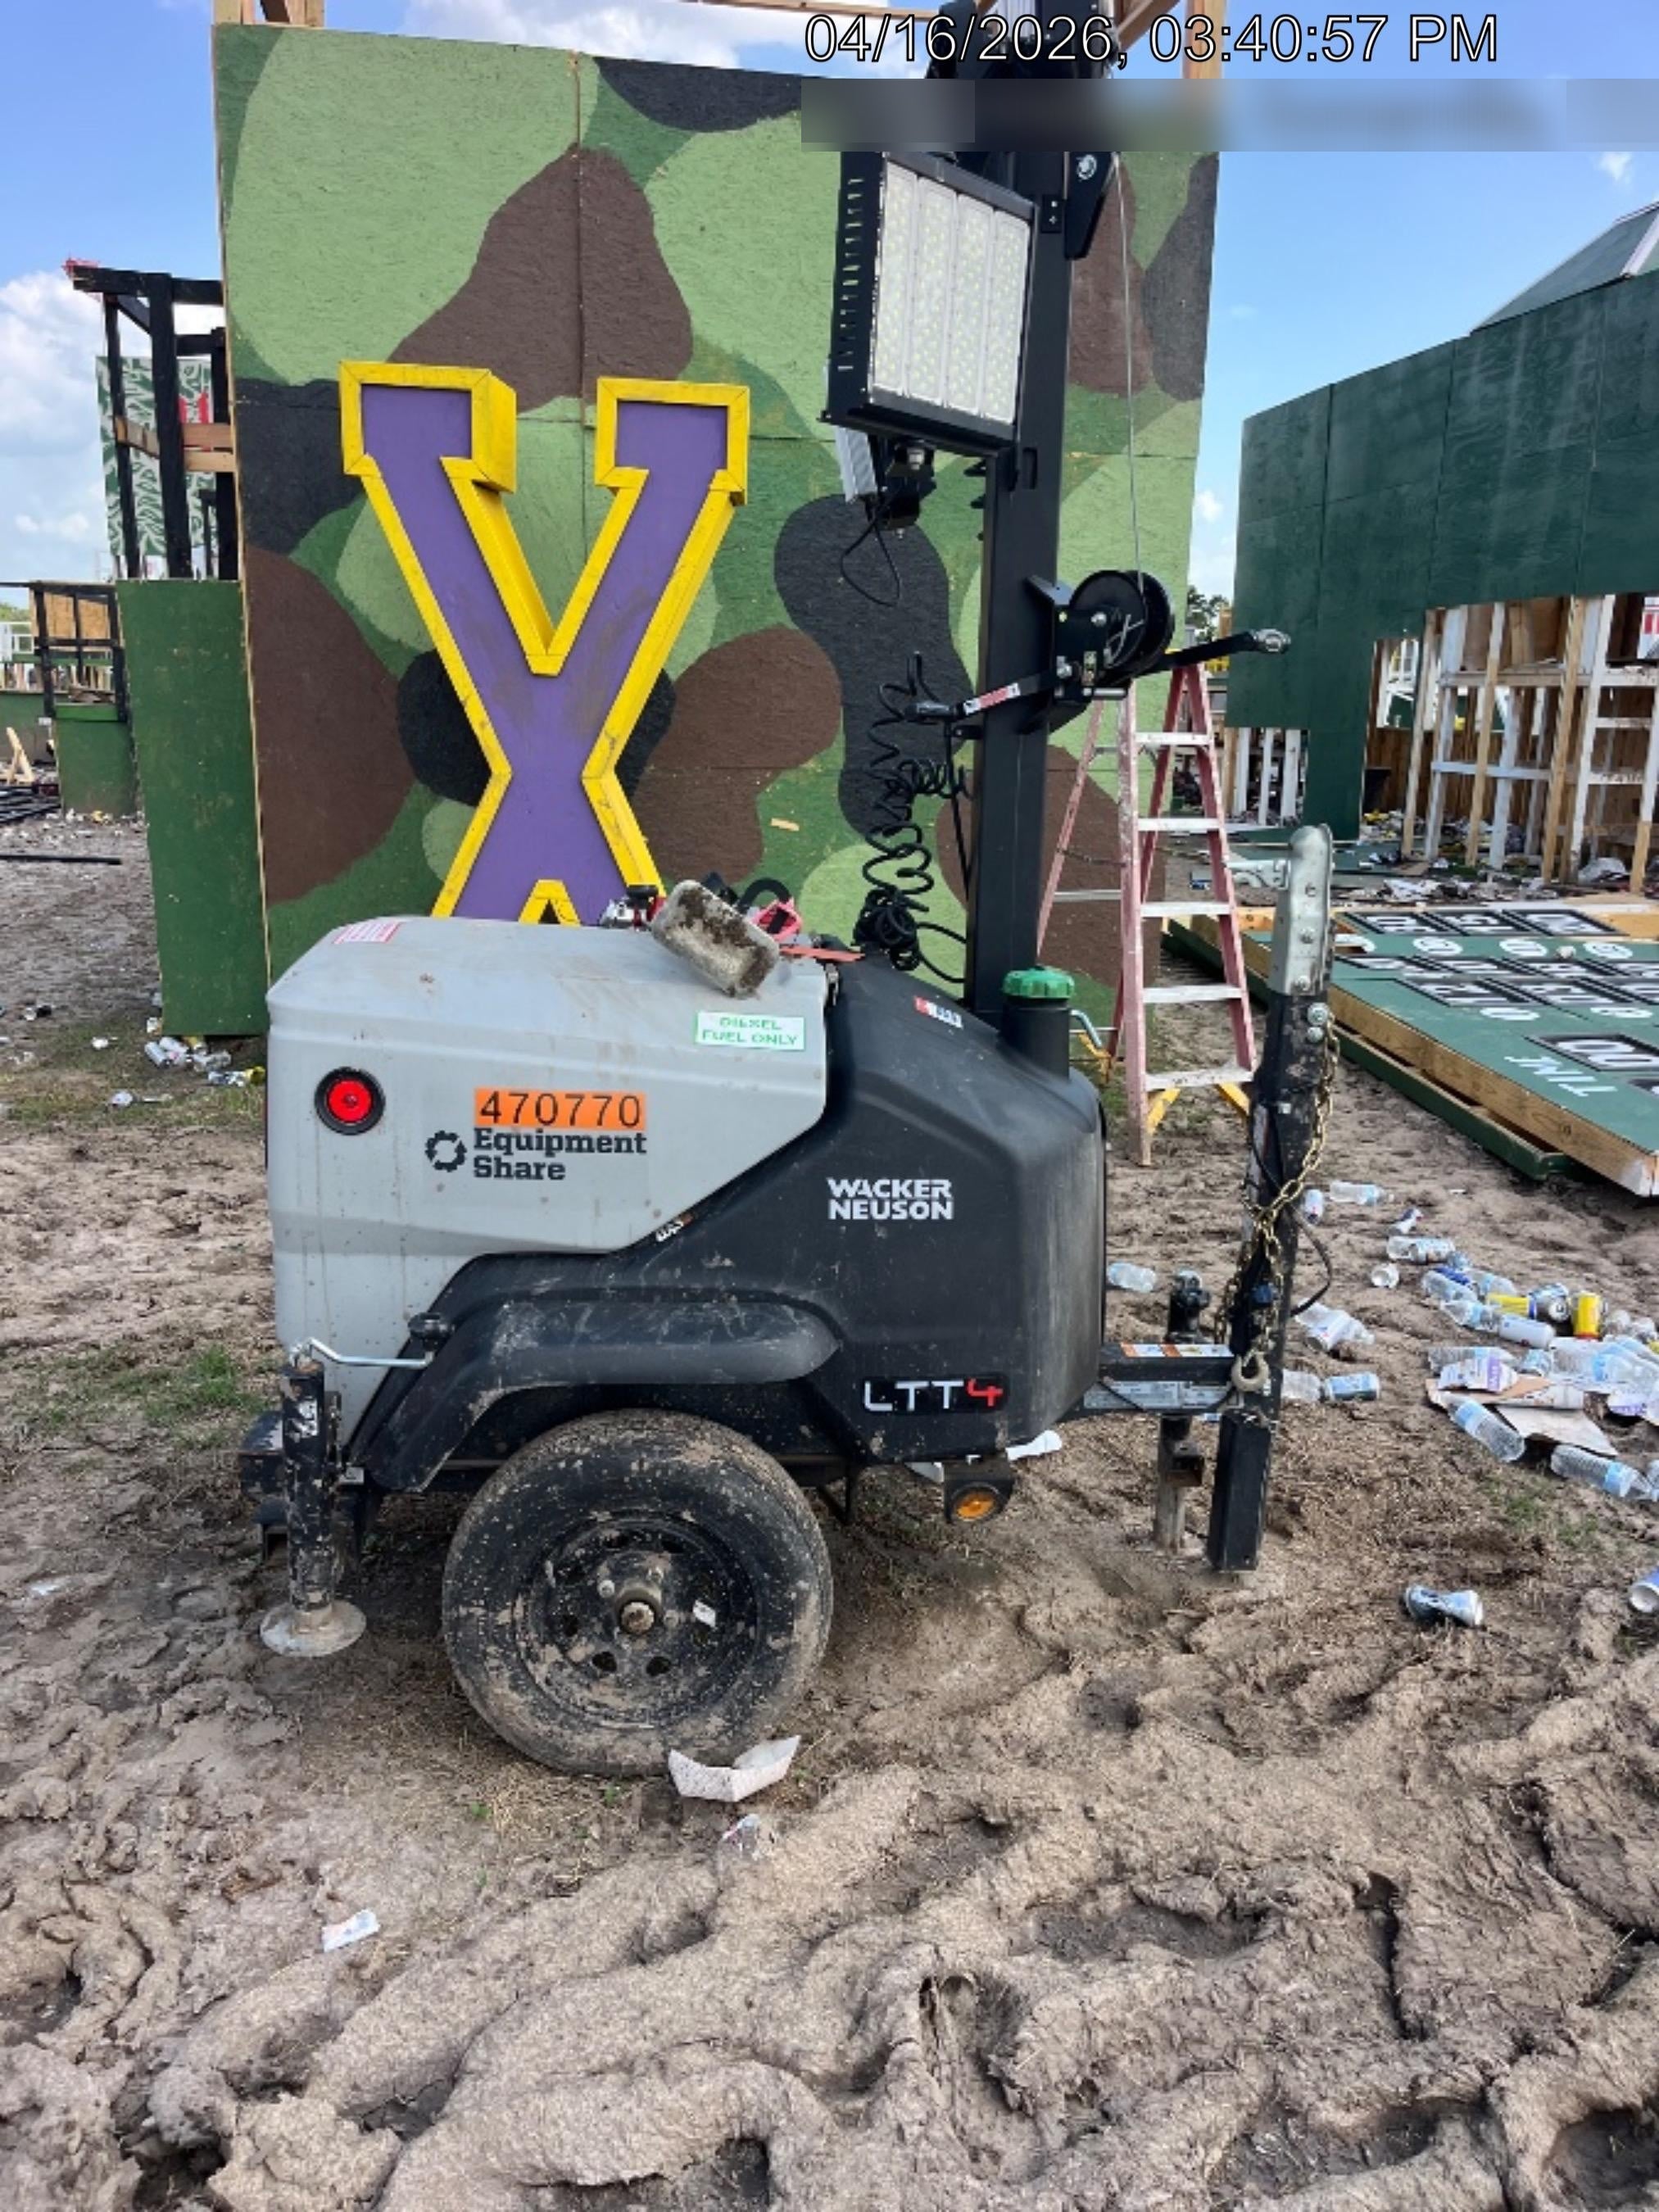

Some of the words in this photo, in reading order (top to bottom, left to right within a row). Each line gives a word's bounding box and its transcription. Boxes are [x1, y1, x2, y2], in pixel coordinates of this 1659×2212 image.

[702, 1029, 747, 1044] FUEL
[751, 1033, 798, 1045] ONLY
[479, 1090, 641, 1128] 470770
[474, 1128, 647, 1157] Equipment
[474, 1156, 567, 1181] Share
[827, 1177, 953, 1199] WACKER
[827, 1199, 954, 1221] NEUSON
[863, 1378, 1004, 1412] LTT4
